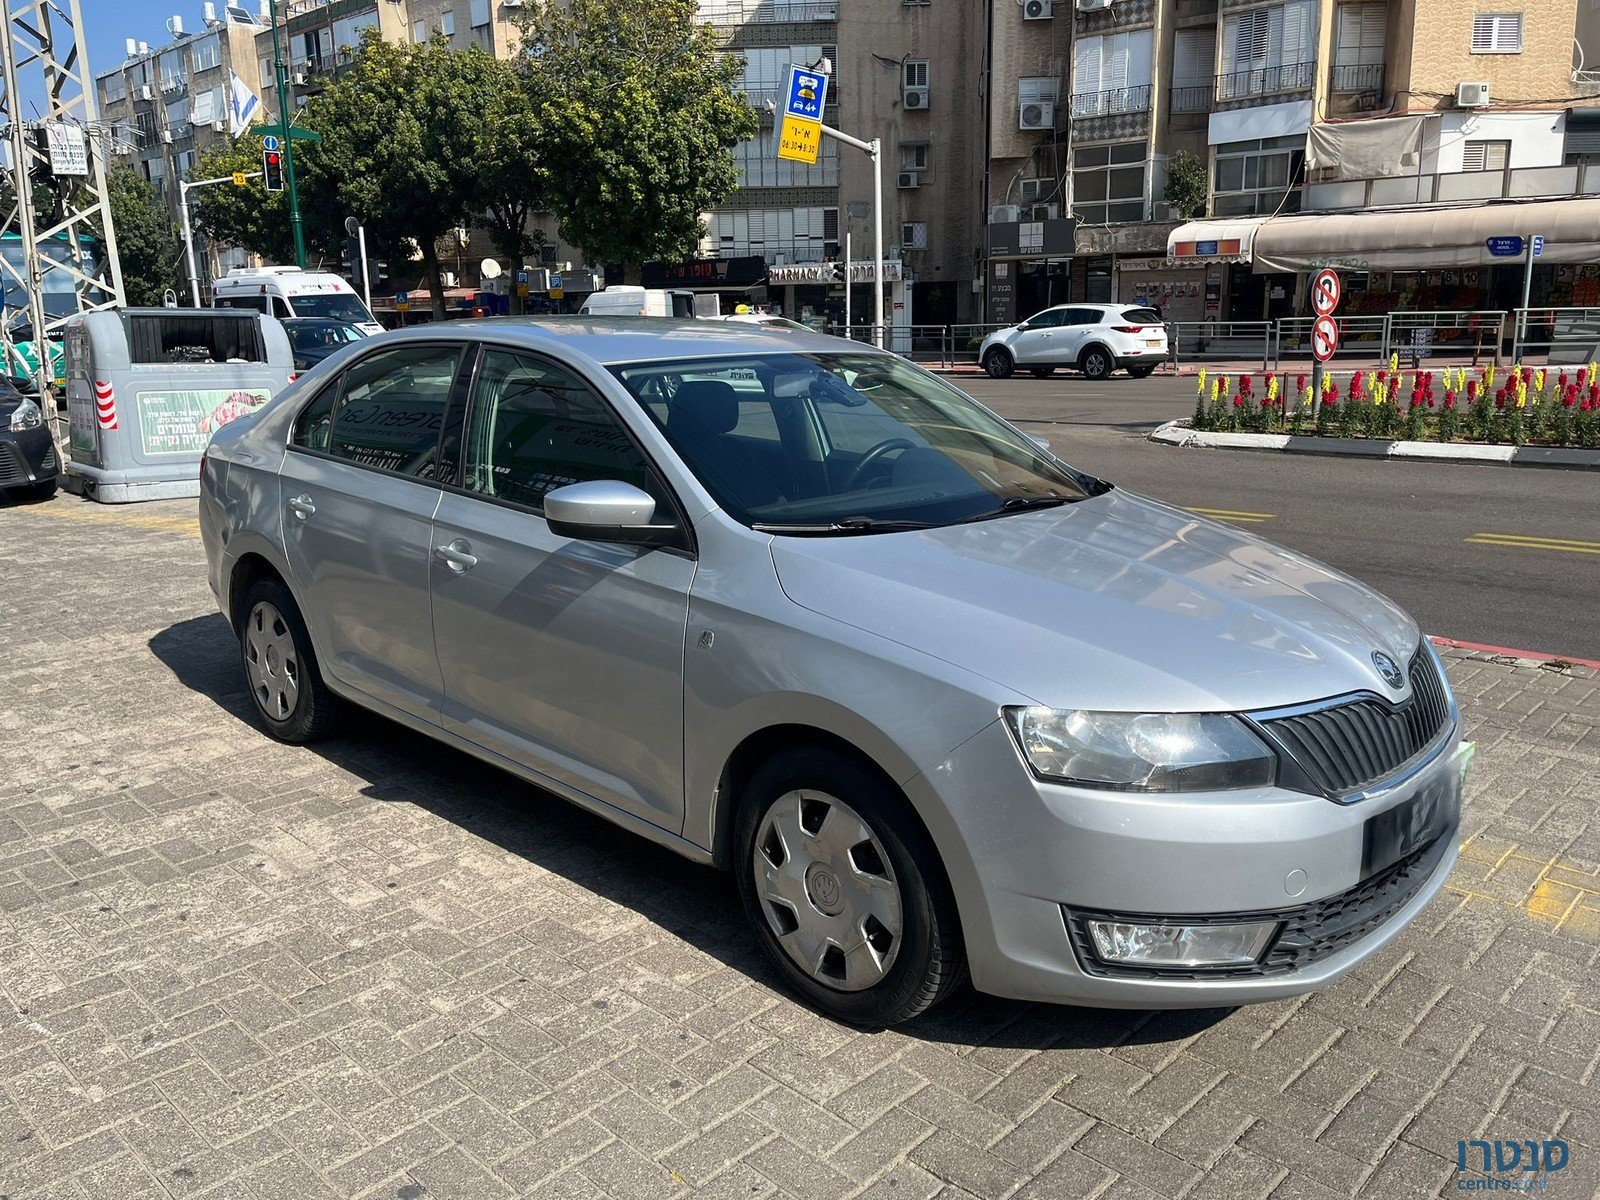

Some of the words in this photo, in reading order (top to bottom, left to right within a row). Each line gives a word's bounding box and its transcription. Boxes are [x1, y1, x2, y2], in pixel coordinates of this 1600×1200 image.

[805, 102, 816, 112] 4+
[234, 174, 244, 183] 13
[1464, 272, 1478, 283] 10
[157, 423, 197, 435] שומרים
